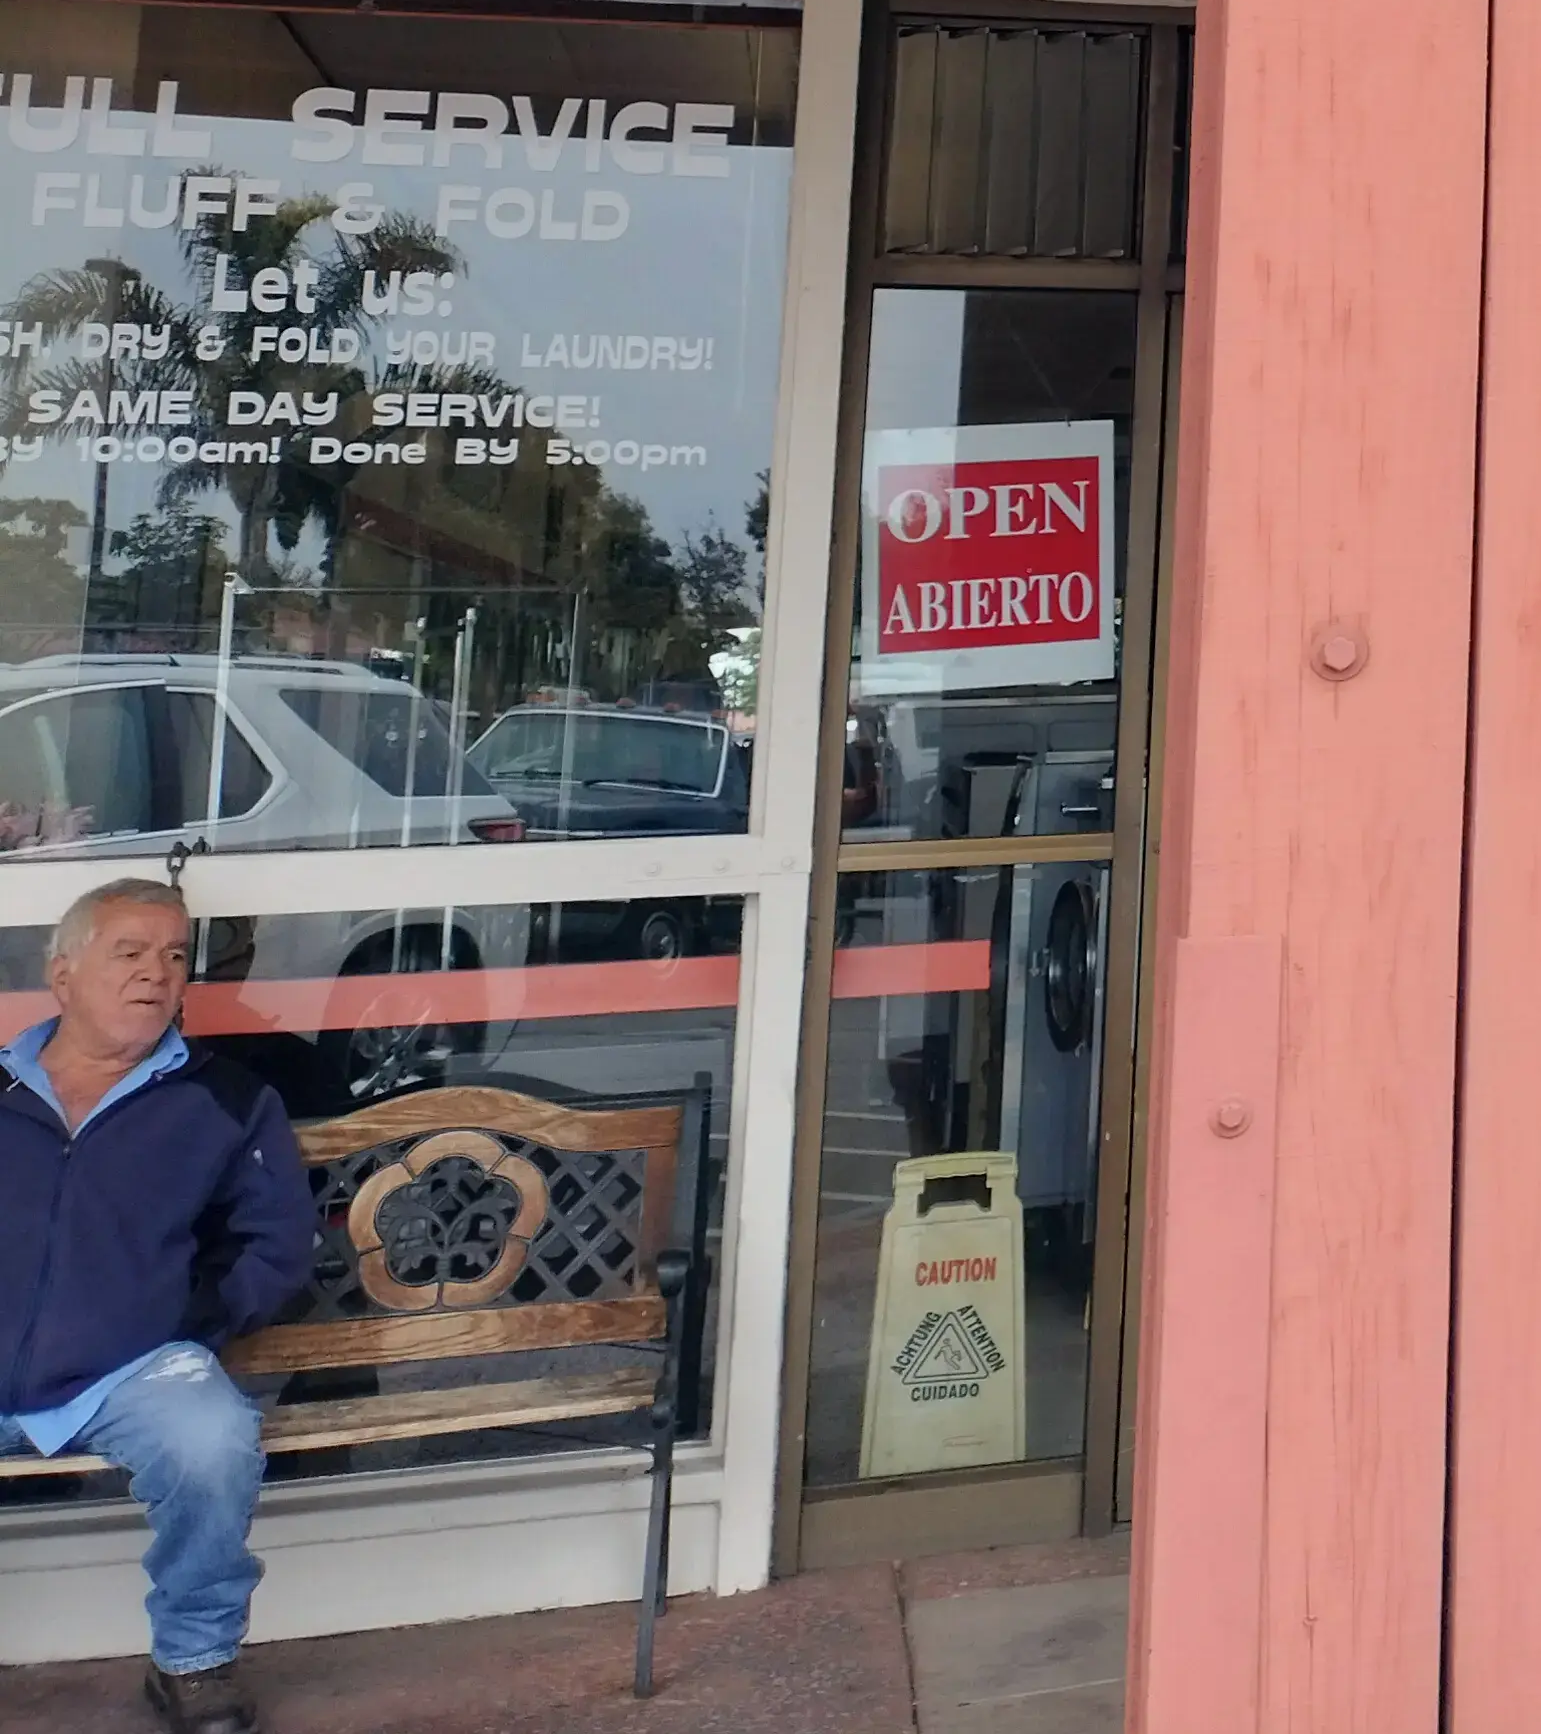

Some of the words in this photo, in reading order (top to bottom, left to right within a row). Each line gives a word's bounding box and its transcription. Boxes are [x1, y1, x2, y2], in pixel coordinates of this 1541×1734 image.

[0, 73, 212, 158] ULL
[291, 86, 735, 178] SERVICE
[32, 172, 281, 232] FLUFF
[332, 182, 384, 234] &
[437, 186, 630, 241] FOLD
[211, 254, 319, 314] Let
[363, 267, 453, 316] us:
[83, 323, 170, 360] DRY
[196, 326, 227, 361] &
[251, 326, 361, 364] FOLD
[386, 331, 495, 368] YOUR
[521, 334, 713, 371] LAUNDRY!
[28, 390, 193, 424] SAME
[227, 391, 338, 426] DAY
[371, 394, 601, 429] SERVICE!
[0, 436, 43, 462] Y
[77, 436, 281, 464] 10:00am!
[309, 438, 426, 466] Done
[455, 438, 520, 466] BY
[546, 439, 707, 471] 5:00pm
[887, 480, 1090, 544] OPEN
[883, 571, 1094, 635] ABIERTO
[915, 1257, 997, 1286] CAUTION
[891, 1311, 943, 1376] ACHTUNG
[956, 1304, 1006, 1372] ATTENTION
[910, 1383, 980, 1402] CUIDADO
